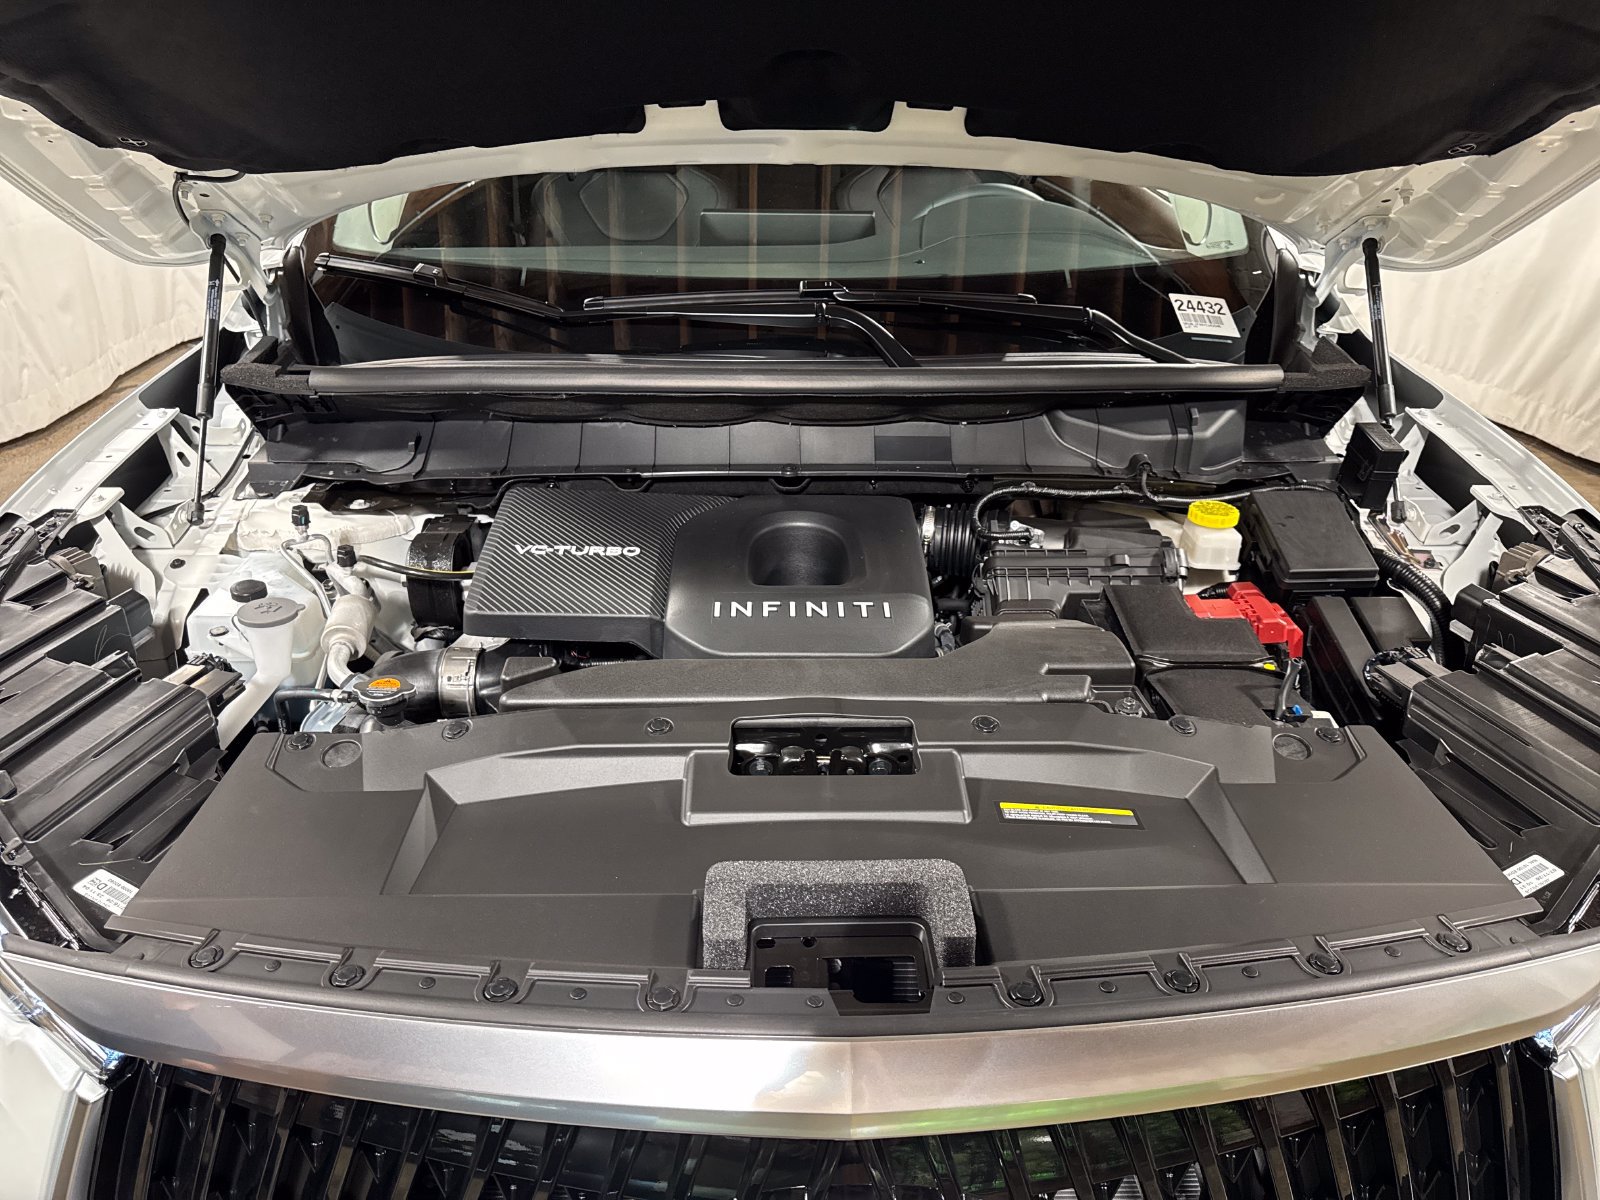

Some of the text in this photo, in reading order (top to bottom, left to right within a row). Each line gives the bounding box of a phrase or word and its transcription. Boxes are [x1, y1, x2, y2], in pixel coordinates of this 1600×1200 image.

[1174, 299, 1226, 315] 24432
[514, 544, 641, 556] VC-TURBO
[713, 601, 891, 618] INFINITI
